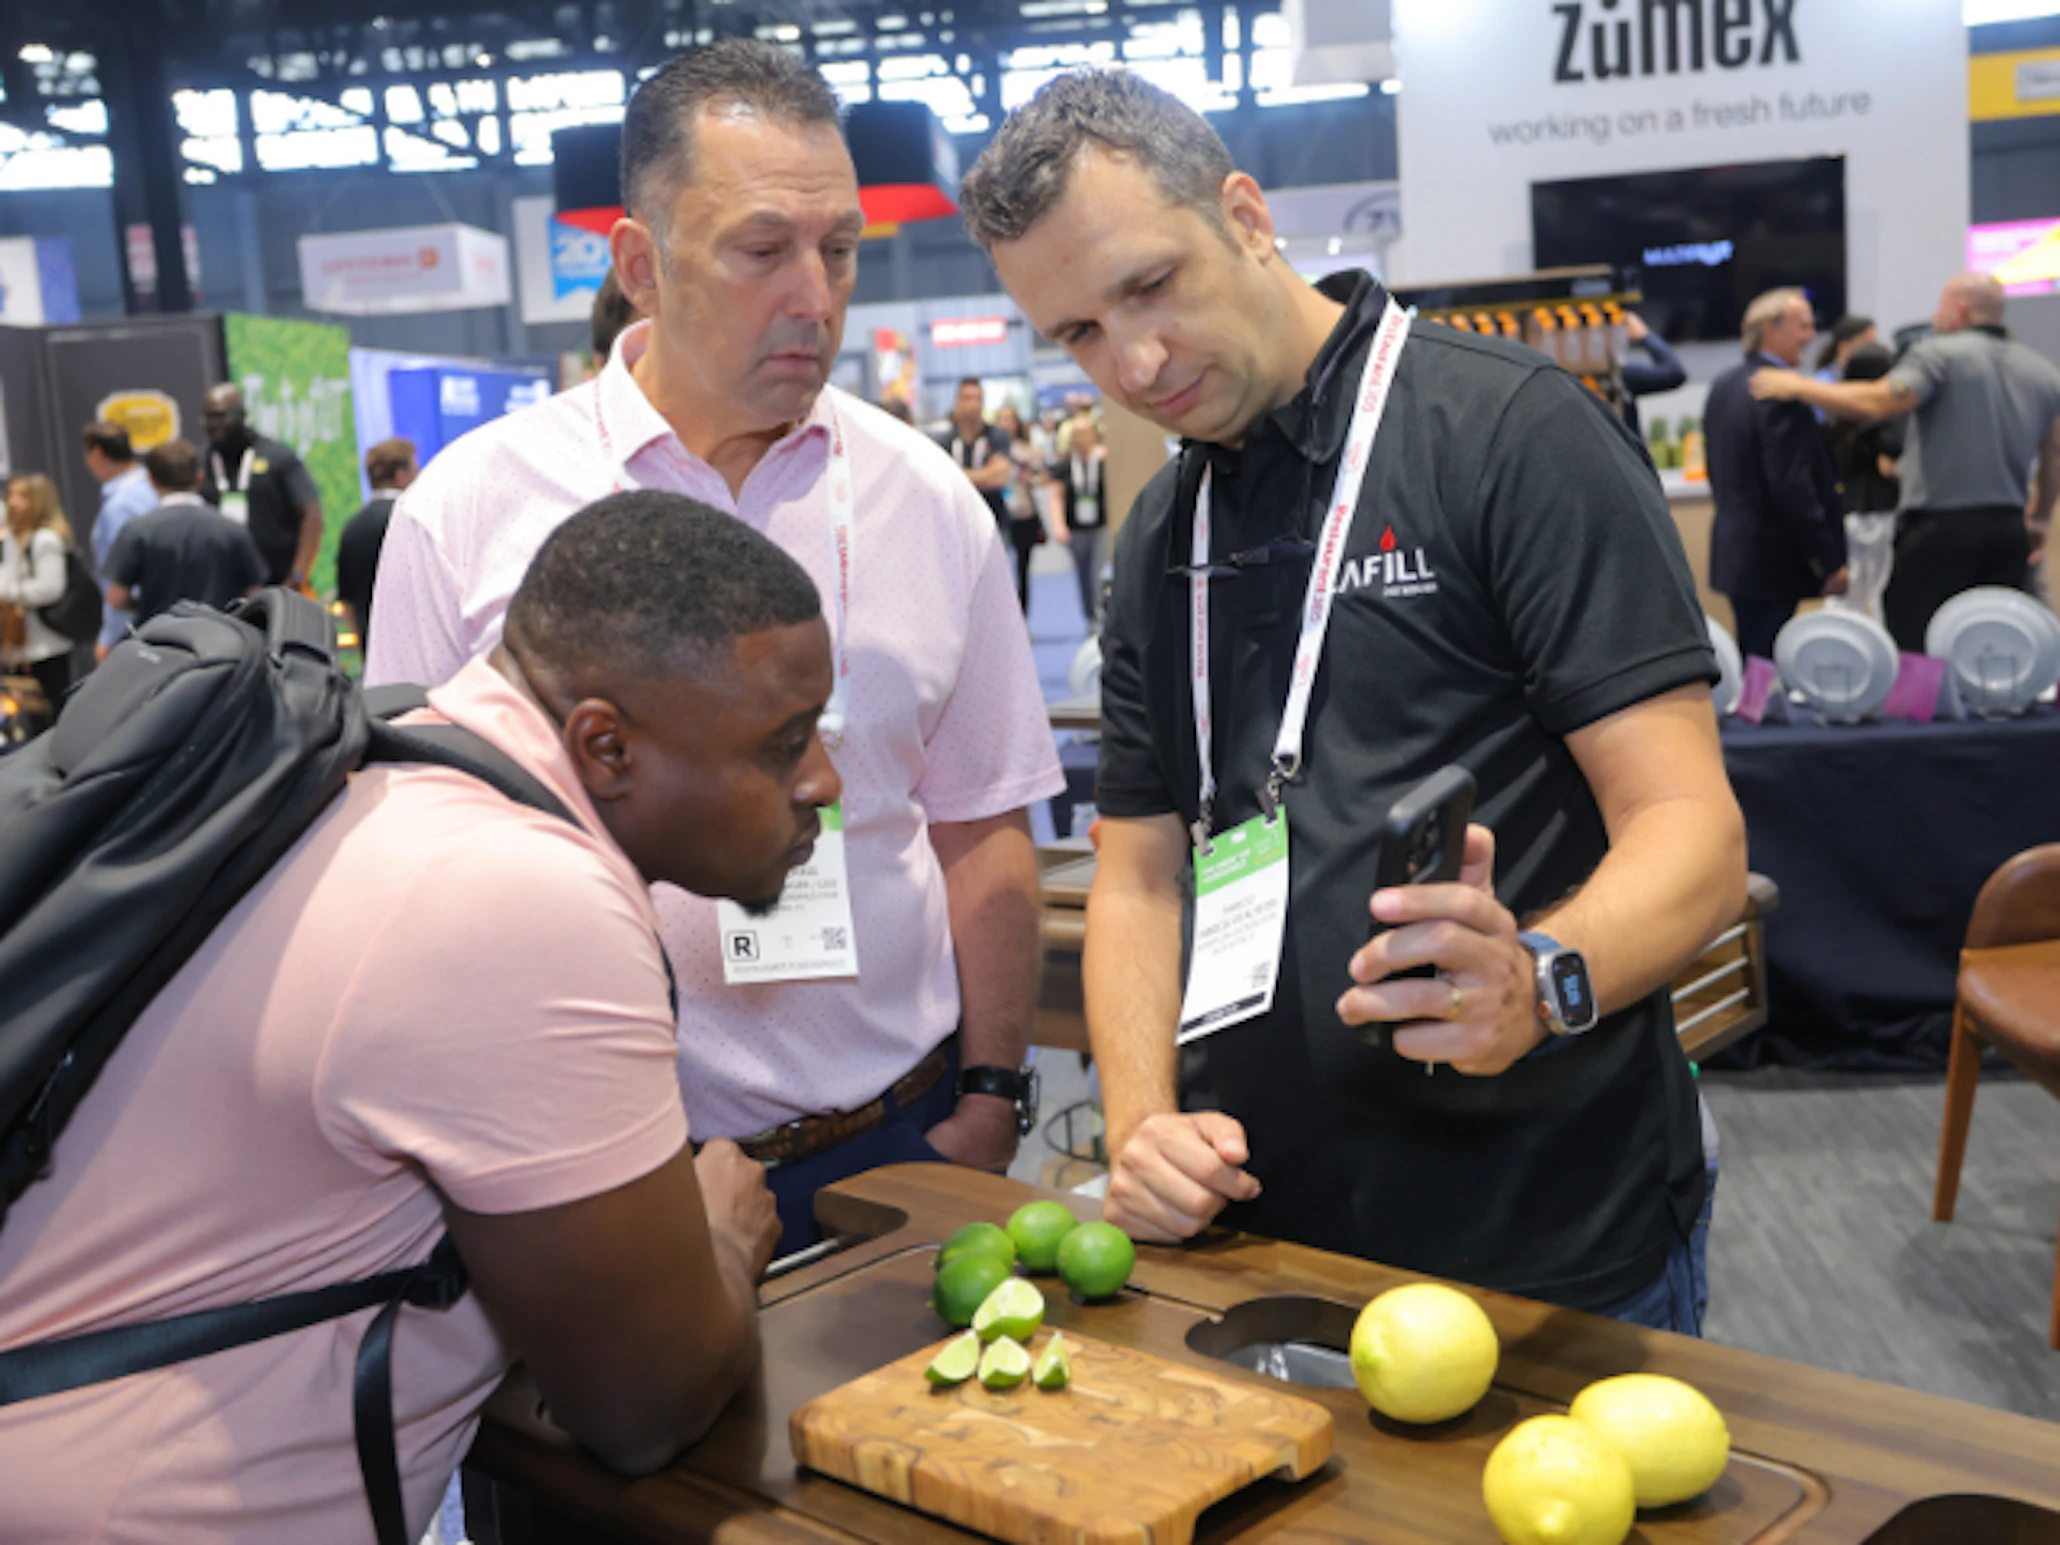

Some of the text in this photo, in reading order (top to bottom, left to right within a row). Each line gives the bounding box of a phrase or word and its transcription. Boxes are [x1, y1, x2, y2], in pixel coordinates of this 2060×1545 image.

[1488, 90, 1873, 145] working on a fresh future
[1331, 548, 1436, 593] AFILL
[733, 935, 752, 957] R
